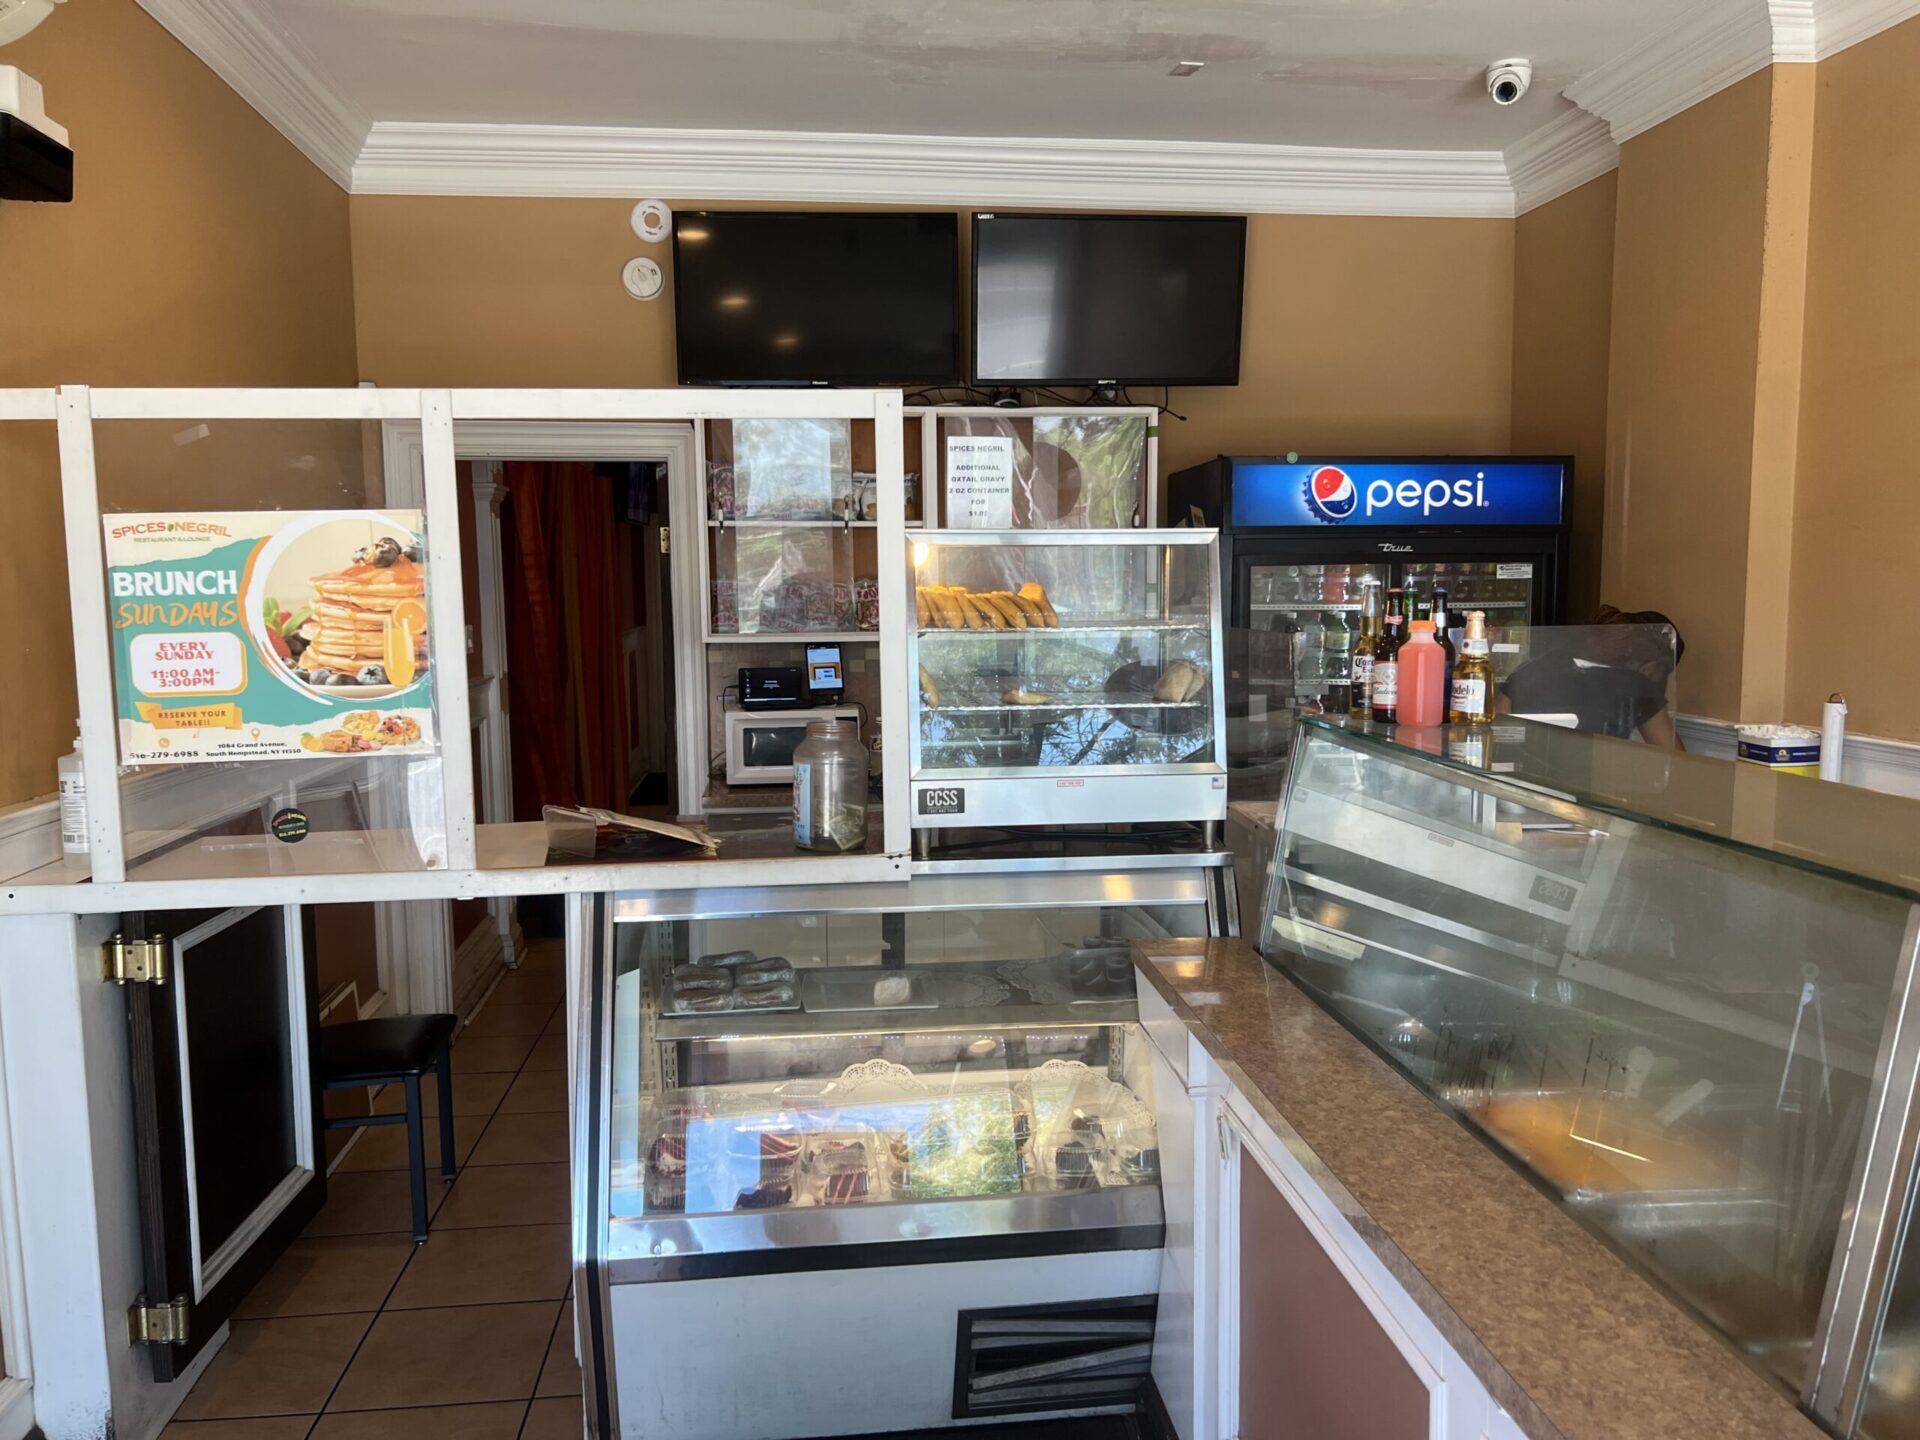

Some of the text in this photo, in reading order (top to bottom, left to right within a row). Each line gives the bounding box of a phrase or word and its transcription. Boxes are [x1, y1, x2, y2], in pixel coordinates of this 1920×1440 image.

[1366, 471, 1485, 516] pepsi
[112, 521, 233, 539] SPICES NEGRIL
[112, 569, 238, 597] BRUNCH
[159, 641, 208, 652] EVERY
[154, 650, 214, 661] SUNDAY
[151, 668, 190, 679] 11:00
[158, 677, 215, 688] 3:00PM
[158, 710, 227, 719] RESERVE YOUR
[129, 750, 199, 760] 516-279-6988
[926, 790, 958, 807] CCSS
